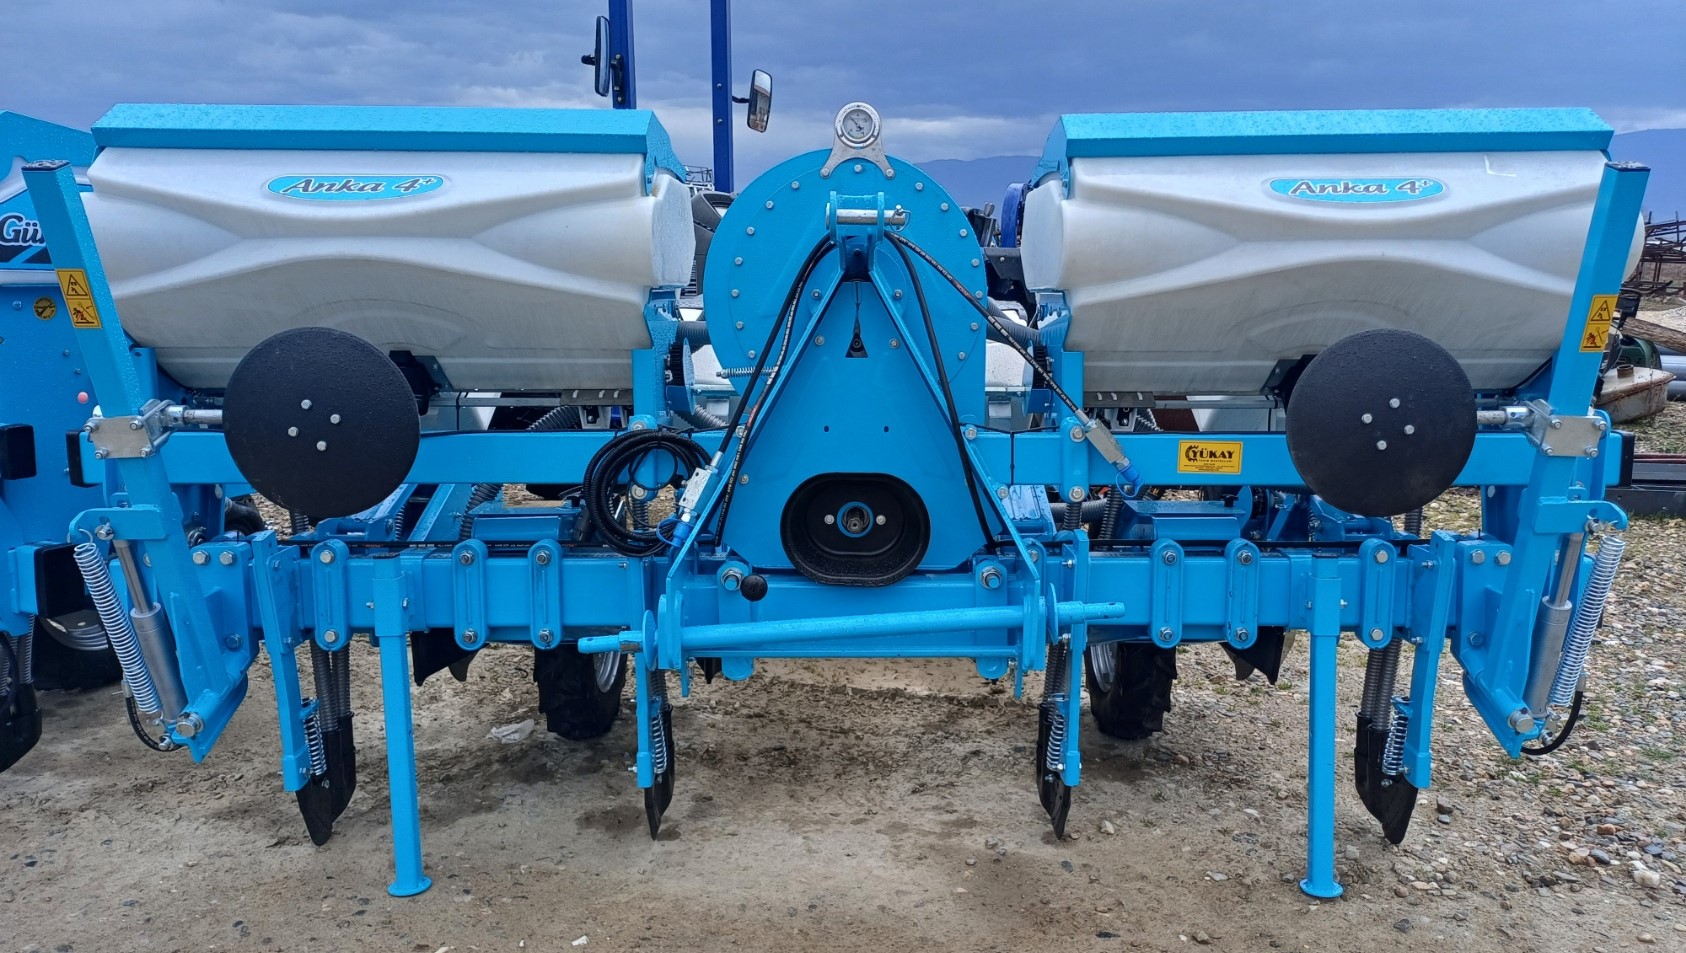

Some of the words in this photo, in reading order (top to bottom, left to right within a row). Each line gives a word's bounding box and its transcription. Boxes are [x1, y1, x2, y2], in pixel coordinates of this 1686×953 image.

[281, 178, 385, 194] Anka
[393, 178, 437, 193] 4+
[1288, 180, 1388, 196] Anka
[1397, 180, 1433, 194] 4+
[1191, 447, 1235, 459] YÜKAY
